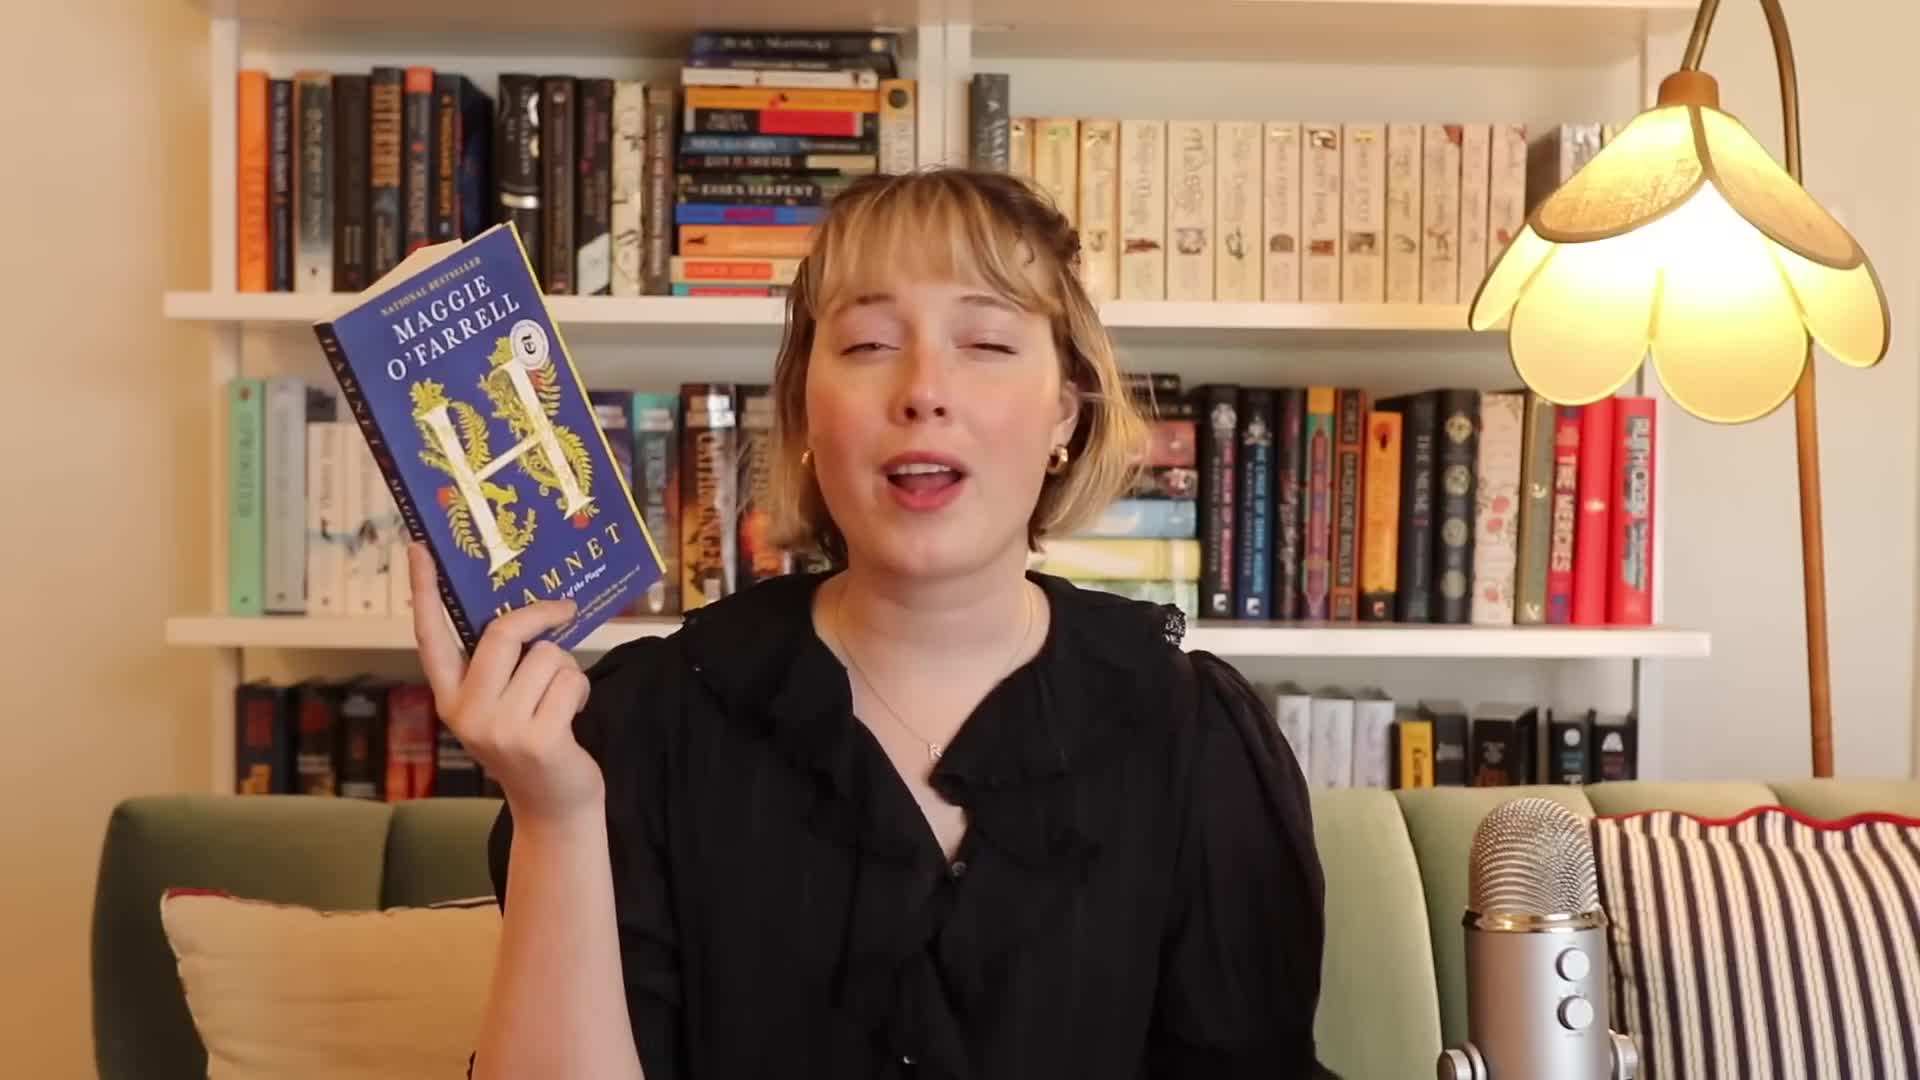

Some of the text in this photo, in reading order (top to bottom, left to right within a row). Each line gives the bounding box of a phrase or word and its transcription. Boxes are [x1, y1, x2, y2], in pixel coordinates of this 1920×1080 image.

[381, 256, 481, 317] NATIONAL BESTSELLER
[391, 275, 491, 344] MAGGIE
[387, 293, 520, 381] O'FARRELL
[1556, 454, 1577, 490] THE
